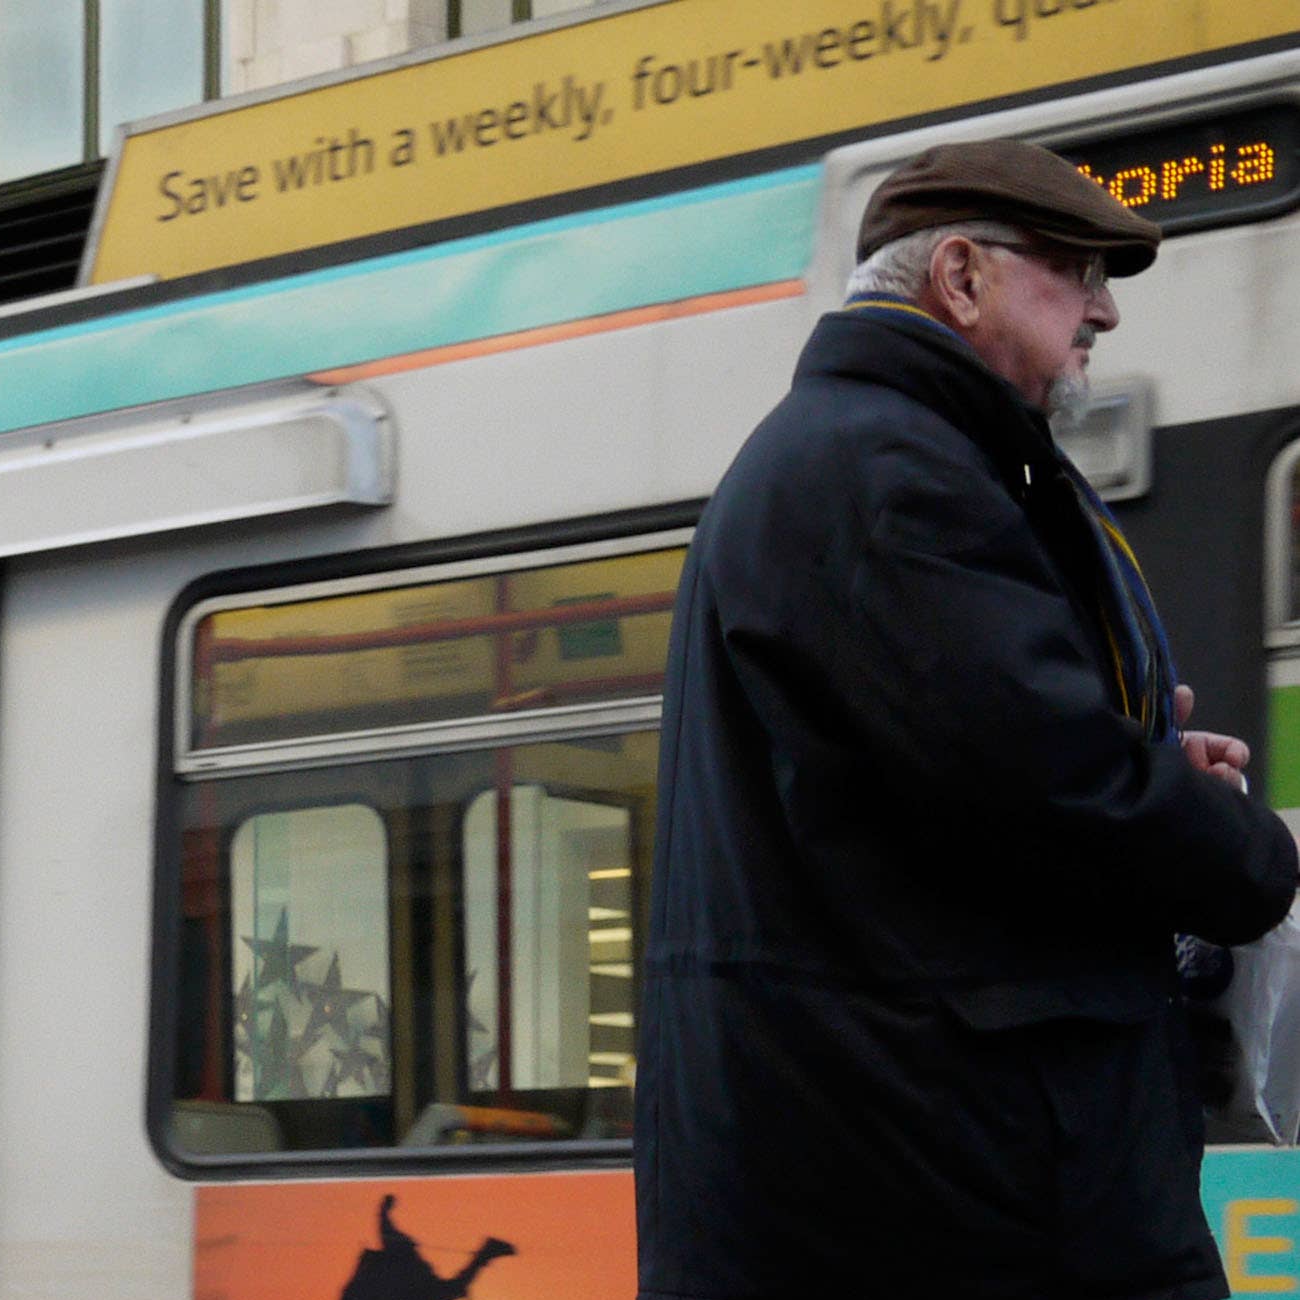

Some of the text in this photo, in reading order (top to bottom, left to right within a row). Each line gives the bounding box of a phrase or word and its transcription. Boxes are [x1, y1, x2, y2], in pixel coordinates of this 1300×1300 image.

[157, 0, 1108, 224] Save with a weekly, four-weekly, qu
